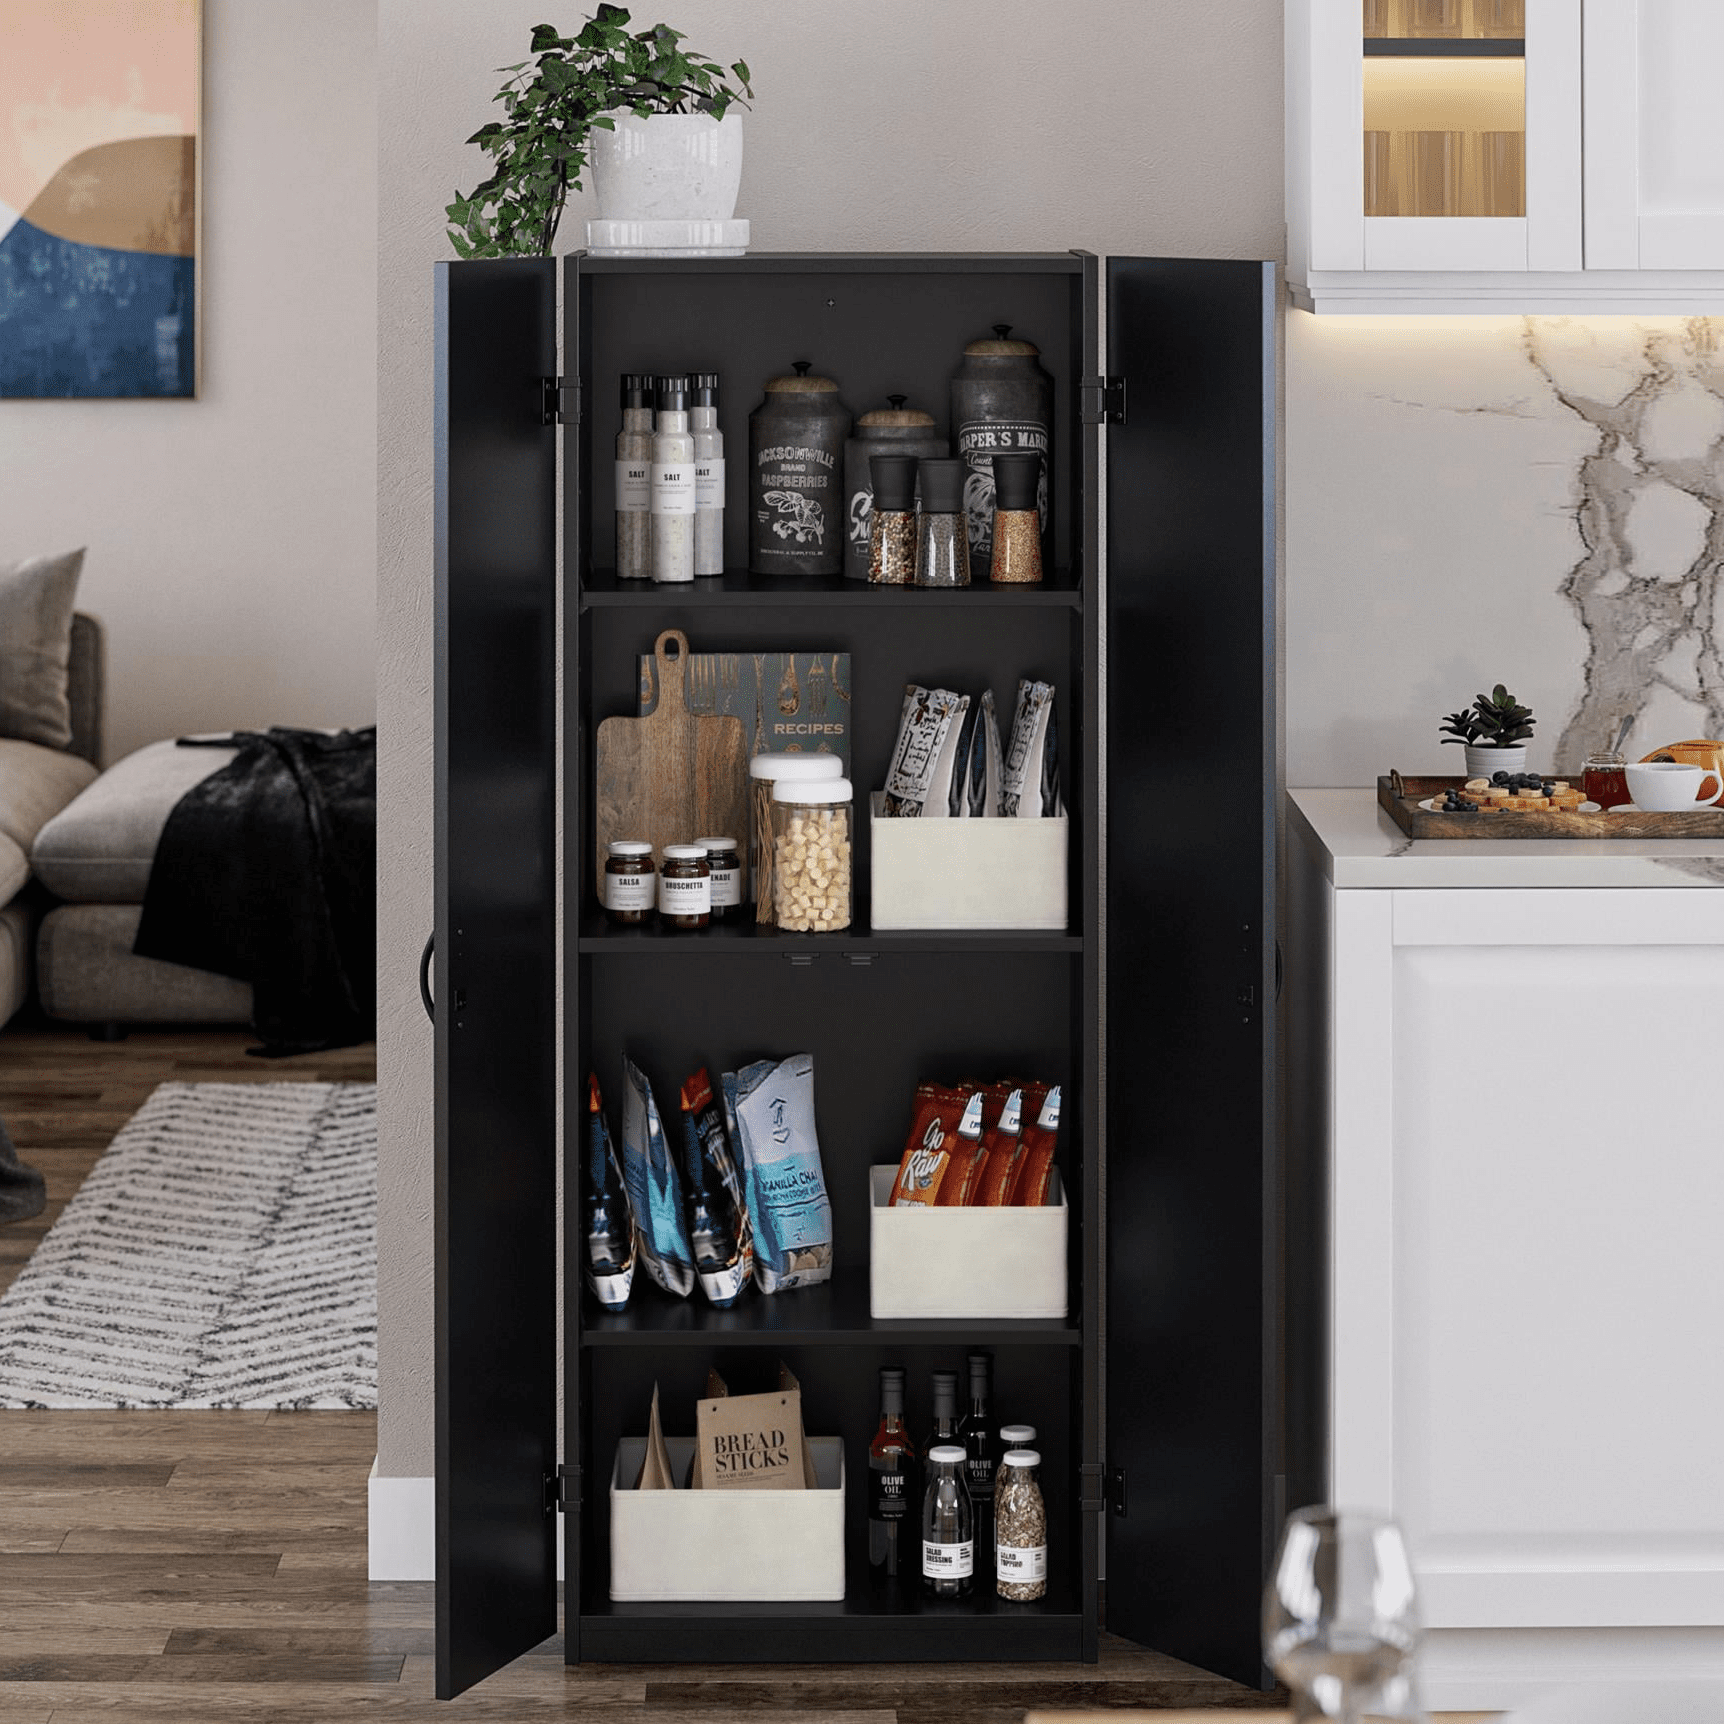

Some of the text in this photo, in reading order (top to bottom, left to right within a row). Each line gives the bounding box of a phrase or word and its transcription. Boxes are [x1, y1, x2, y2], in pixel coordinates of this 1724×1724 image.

[780, 463, 807, 472] BRAND
[628, 470, 645, 478] SALT
[664, 473, 681, 481] SALT
[761, 473, 828, 488] RASPBERRIES
[774, 723, 845, 735] RECIPES
[711, 873, 731, 882] ENADE
[665, 881, 704, 890] BRUSCHETTA
[922, 1116, 945, 1155] Go
[901, 1149, 947, 1191] Raw
[760, 1174, 798, 1192] VANILLA
[713, 1429, 785, 1455] BREAD
[715, 1447, 790, 1473] STICKS
[969, 1459, 992, 1470] OLIVE
[973, 1469, 990, 1479] OIL
[881, 1474, 905, 1486] OLIVE
[884, 1485, 902, 1495] OIL
